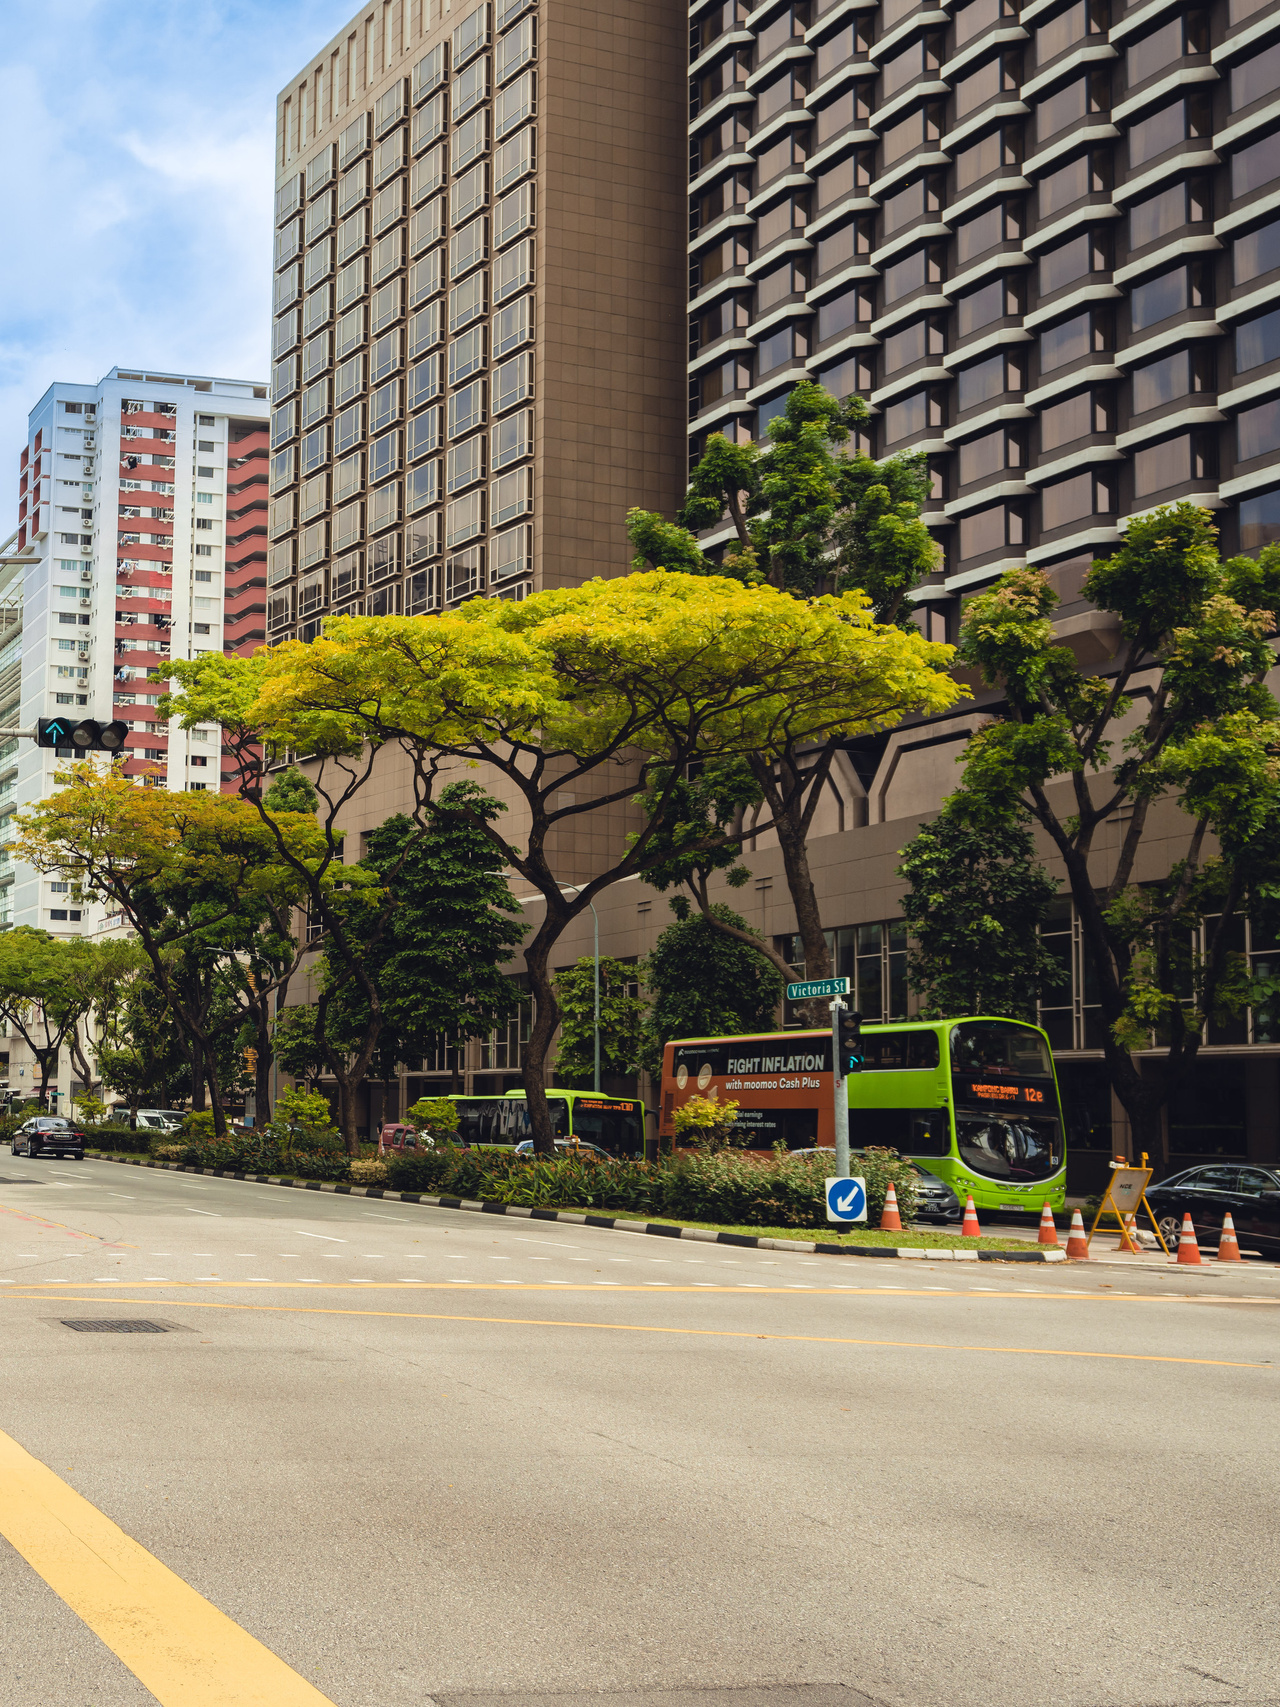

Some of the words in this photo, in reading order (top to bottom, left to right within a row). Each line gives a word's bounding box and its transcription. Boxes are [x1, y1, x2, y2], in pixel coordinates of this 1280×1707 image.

[792, 982, 831, 997] Victoria
[834, 980, 844, 993] St
[727, 1057, 761, 1074] FIGHT
[761, 1054, 825, 1073] INFLATION
[725, 1078, 743, 1090] with
[743, 1079, 778, 1090] moomoo
[779, 1077, 800, 1089] Cash
[801, 1076, 820, 1088] Plus
[1024, 1087, 1044, 1102] 12e
[744, 1111, 763, 1119] earnings
[746, 1120, 764, 1128] interest
